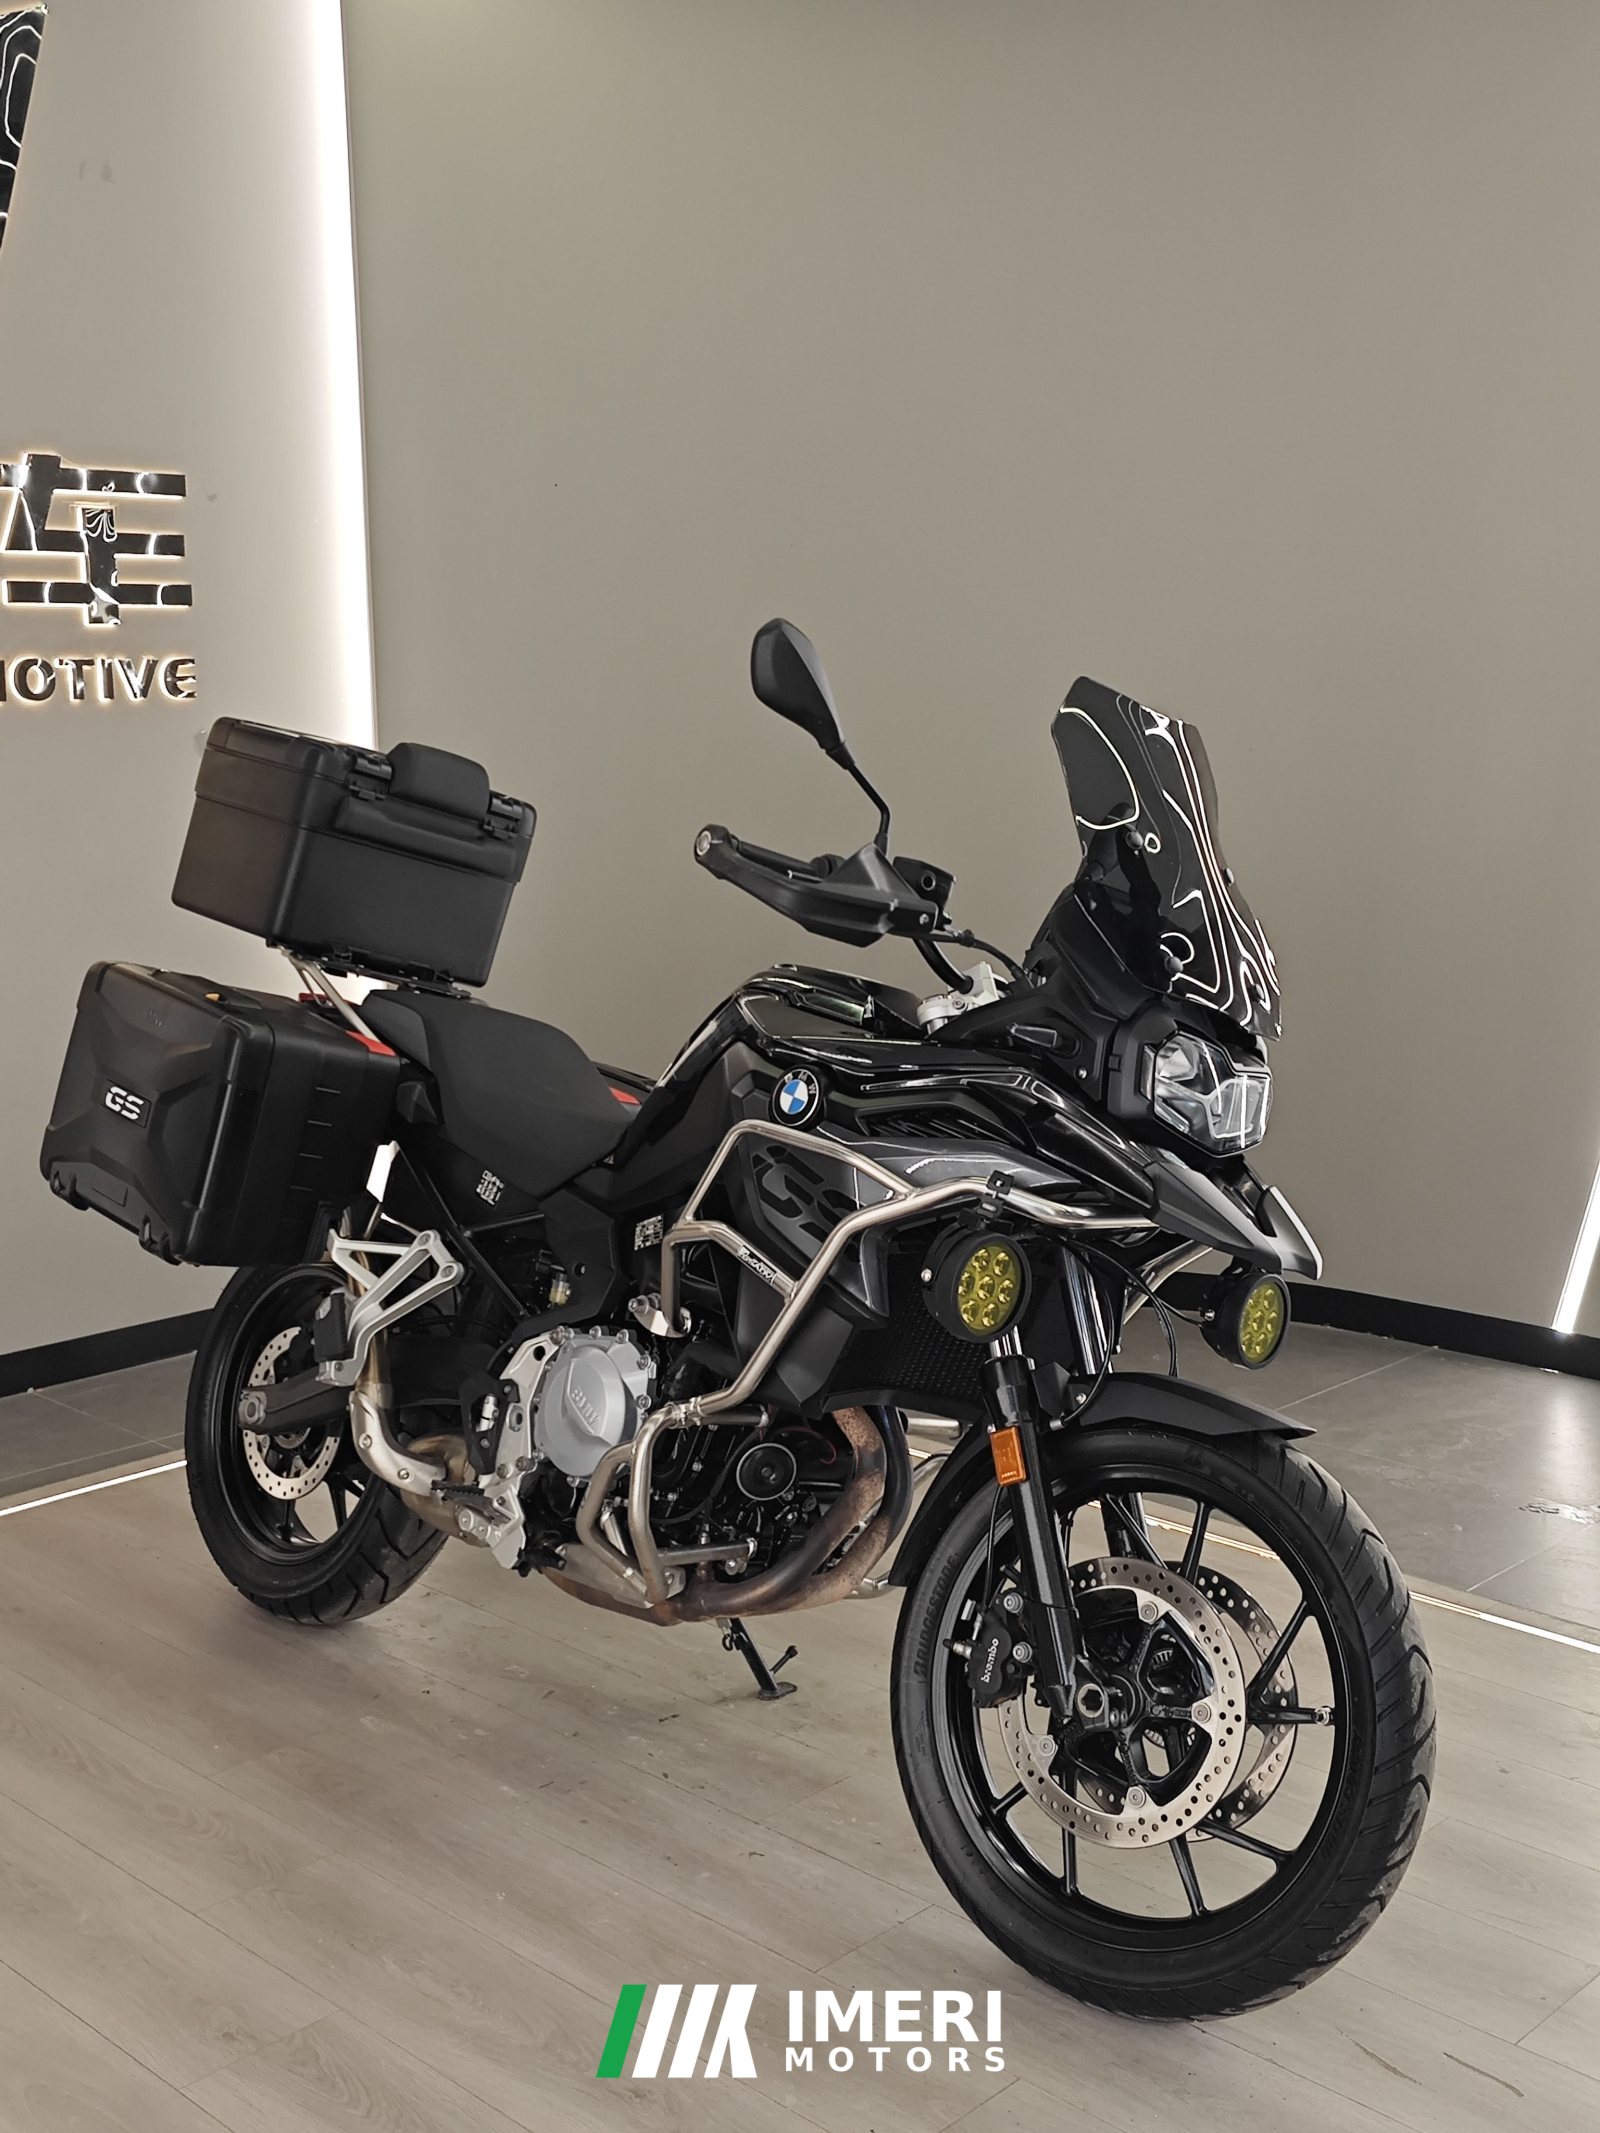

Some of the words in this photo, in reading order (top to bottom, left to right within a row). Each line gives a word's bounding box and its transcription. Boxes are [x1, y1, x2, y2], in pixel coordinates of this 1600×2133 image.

[0, 656, 197, 702] OTIVE
[105, 1086, 144, 1120] GS
[980, 1638, 999, 1684] brembo
